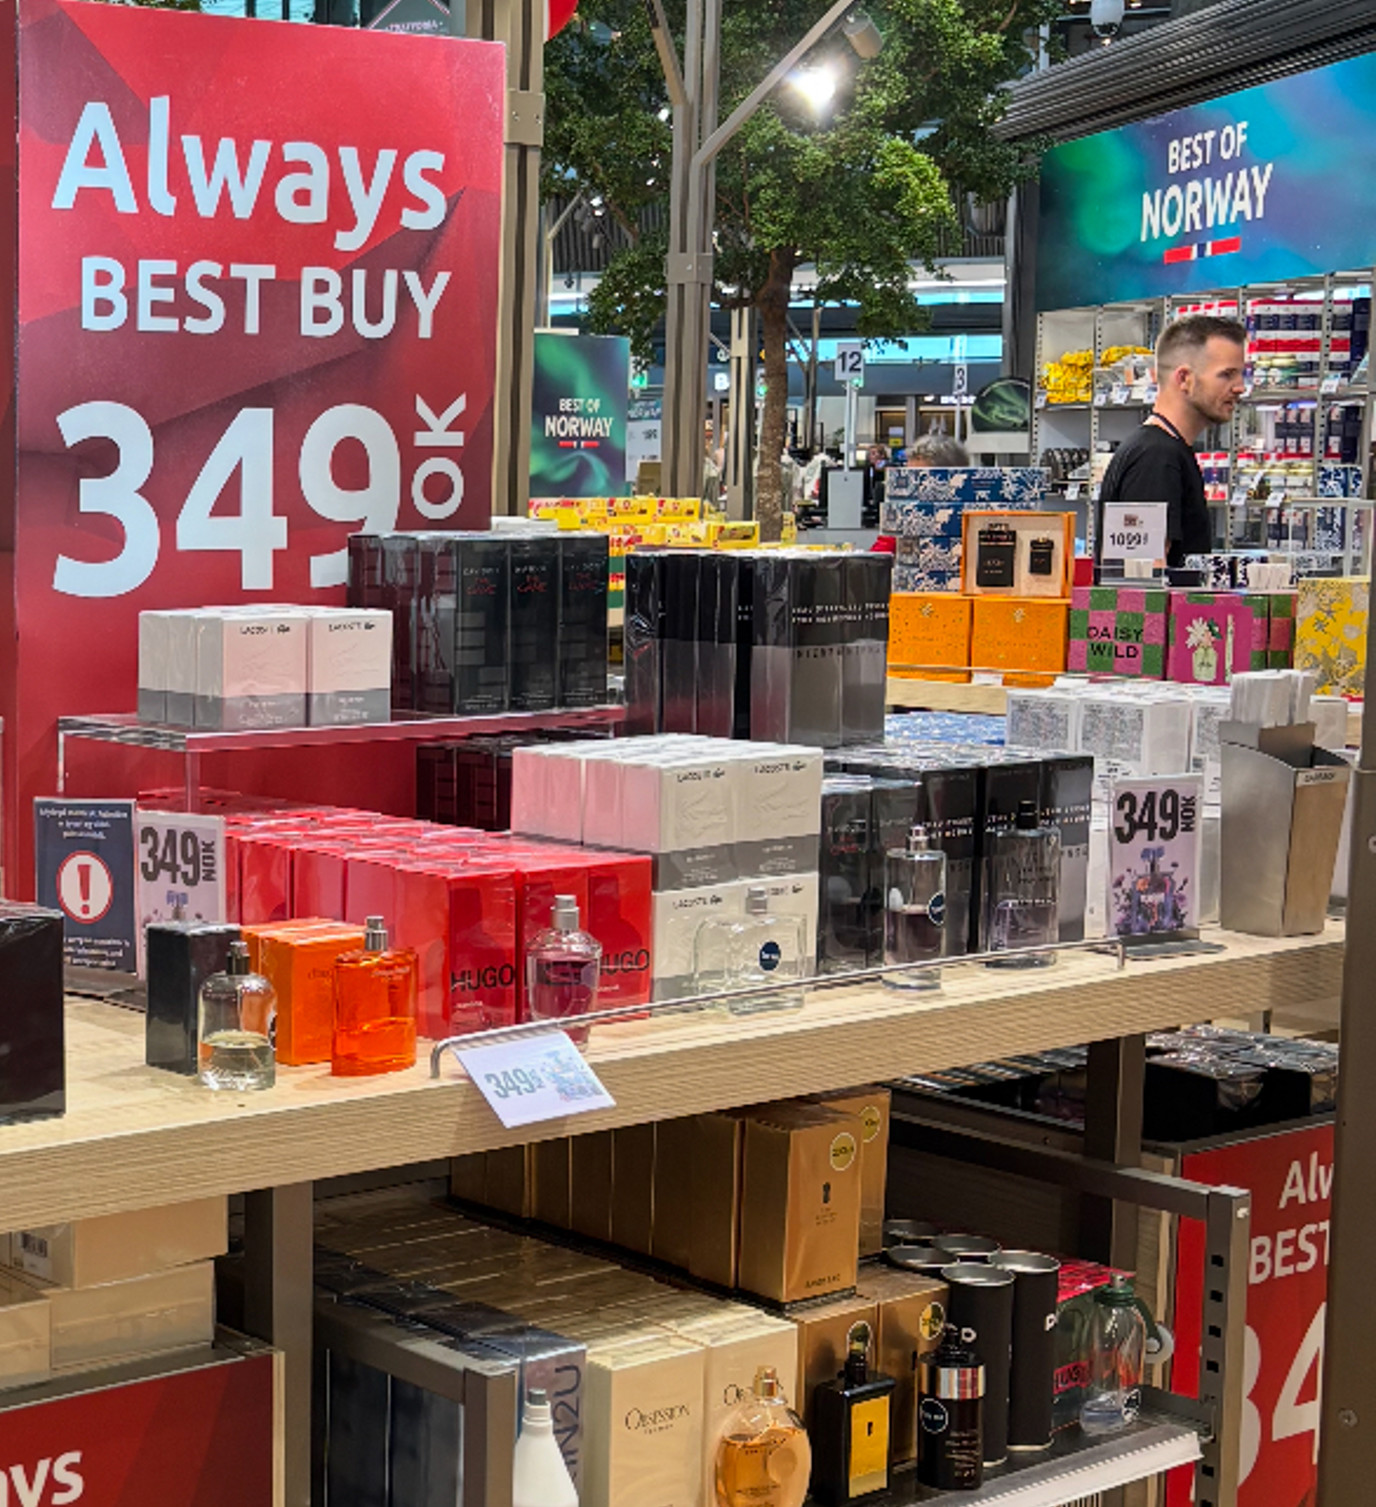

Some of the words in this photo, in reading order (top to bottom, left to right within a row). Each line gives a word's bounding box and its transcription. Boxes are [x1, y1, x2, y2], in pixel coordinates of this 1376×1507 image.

[1168, 131, 1216, 174] BEST
[1220, 121, 1249, 160] OF
[51, 95, 448, 251] Always
[1140, 163, 1273, 242] NORWAY
[81, 256, 276, 335] BEST
[300, 266, 452, 339] BUY
[838, 350, 863, 373] 12
[956, 366, 966, 390] 3
[559, 398, 585, 412] BEST
[544, 416, 614, 438] NORWAY
[52, 400, 401, 598] 349
[1086, 626, 1143, 643] DAISY
[1090, 643, 1139, 659] WILD
[1115, 788, 1179, 844] 349
[1179, 795, 1197, 833] NOK
[140, 826, 201, 887] 349
[200, 839, 217, 882] NOK
[450, 963, 515, 993] HUGO
[484, 1068, 536, 1098] 349
